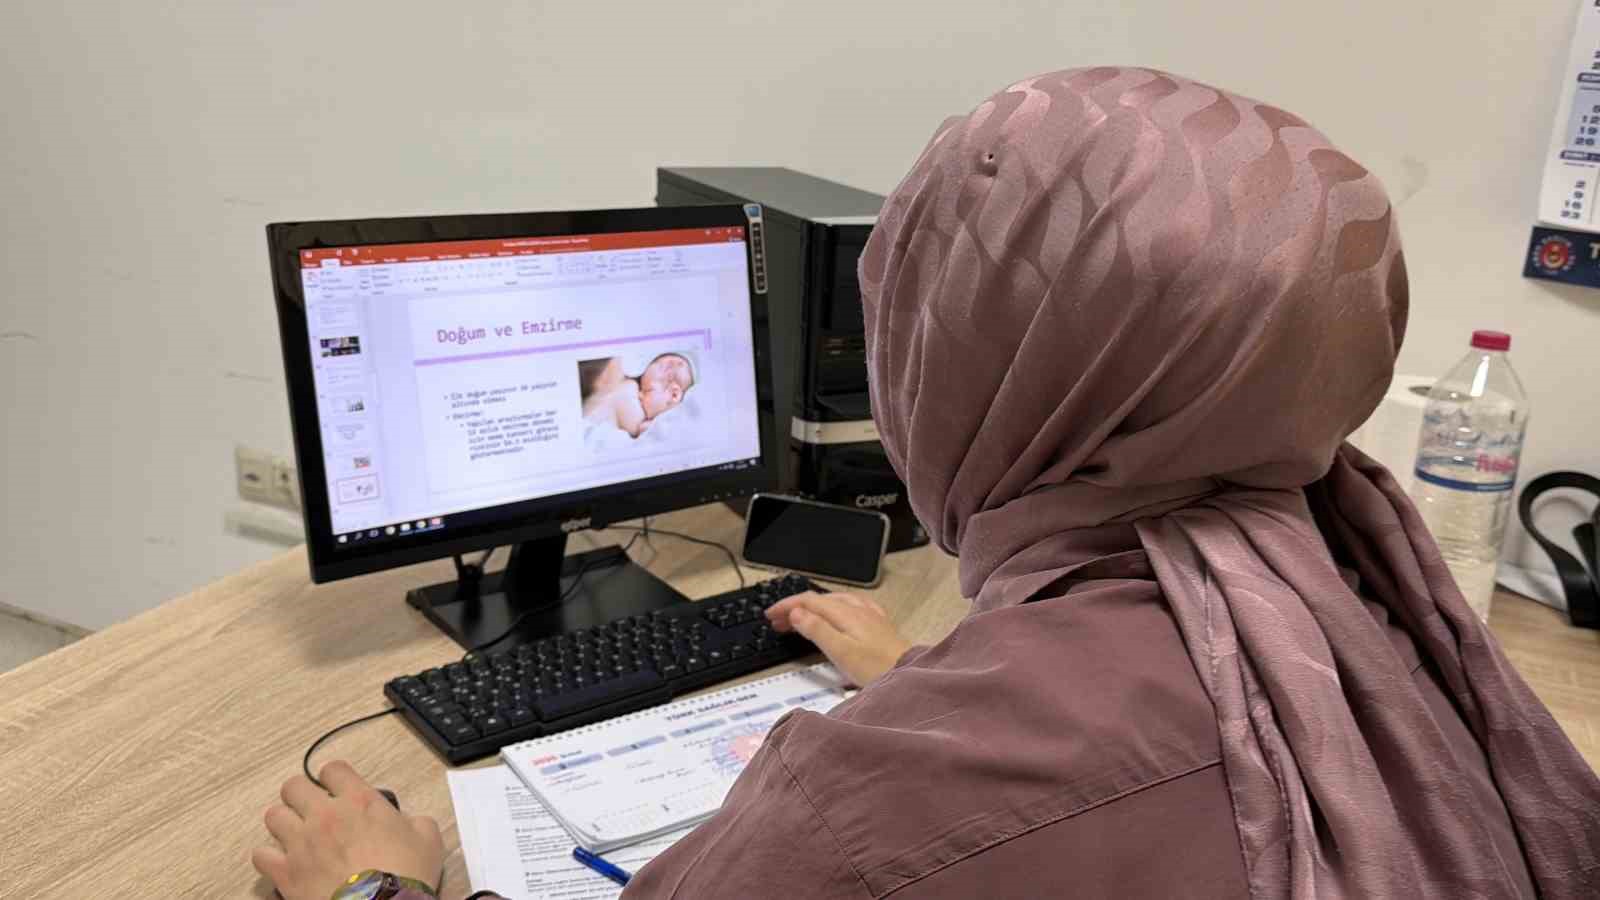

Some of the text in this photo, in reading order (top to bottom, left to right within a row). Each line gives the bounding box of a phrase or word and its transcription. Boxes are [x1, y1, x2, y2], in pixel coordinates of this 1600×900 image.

[437, 318, 583, 344] Doğum ve Emzirme
[856, 493, 898, 509] Casper
